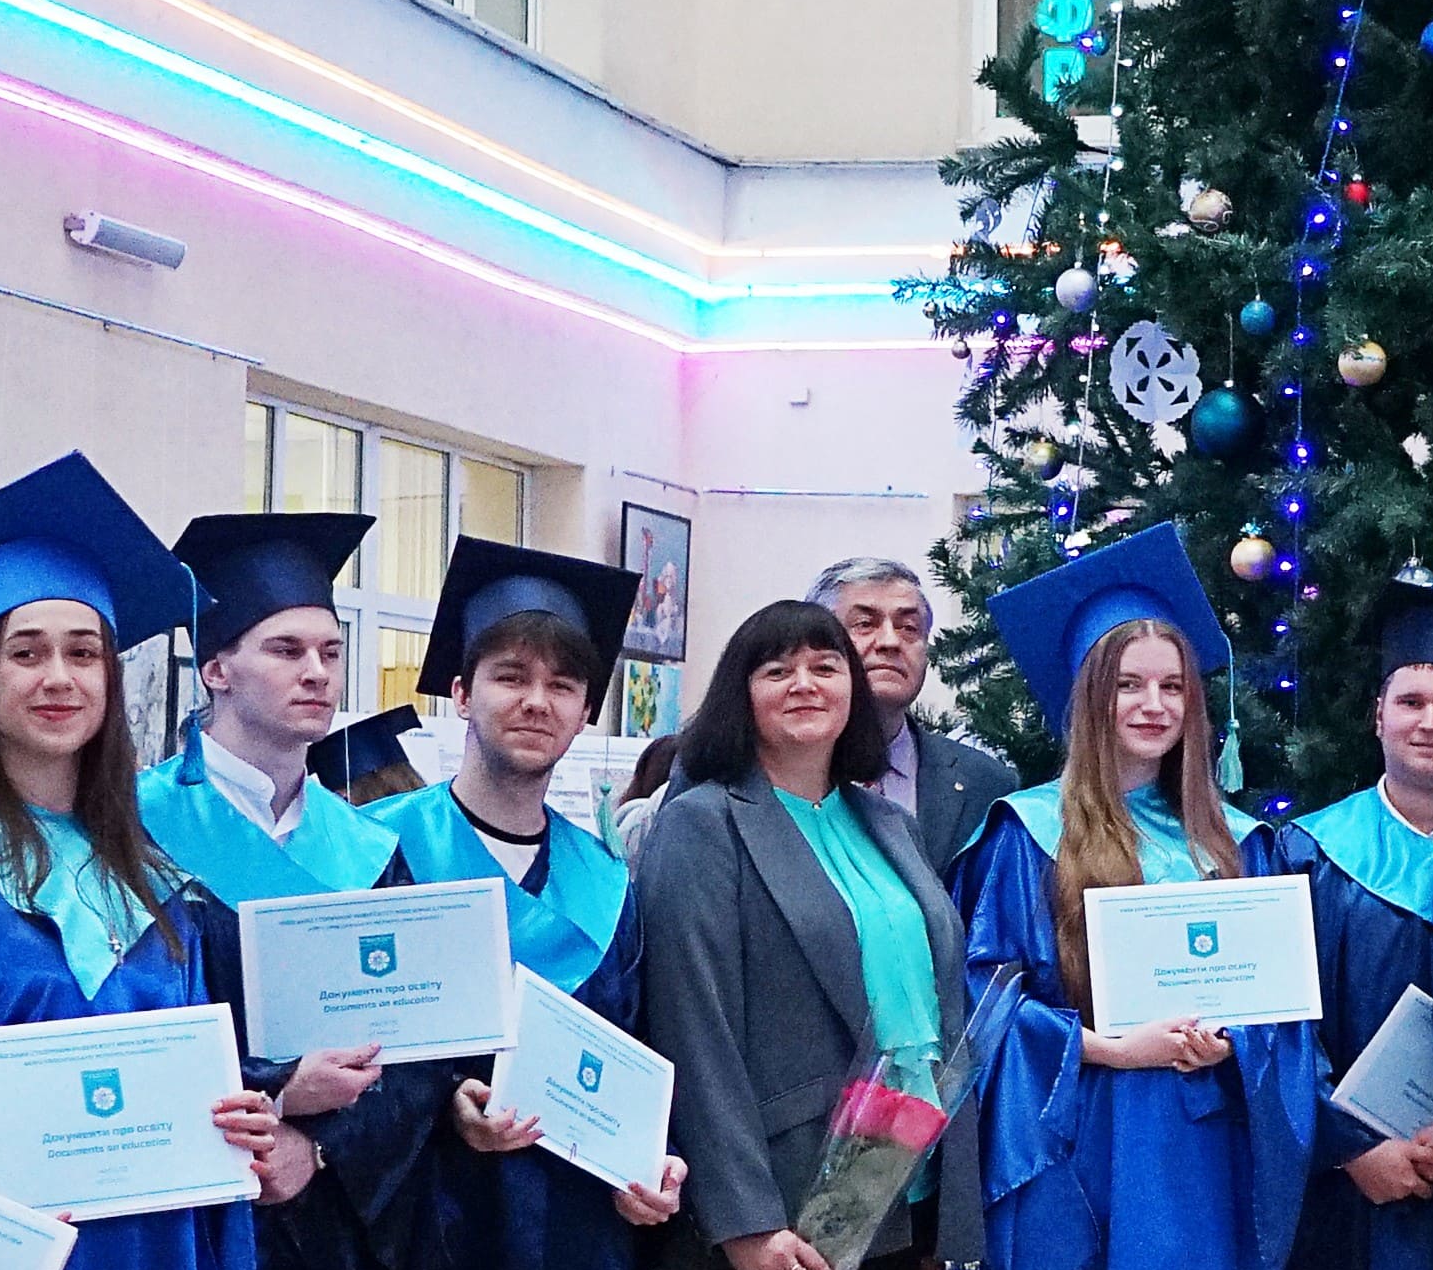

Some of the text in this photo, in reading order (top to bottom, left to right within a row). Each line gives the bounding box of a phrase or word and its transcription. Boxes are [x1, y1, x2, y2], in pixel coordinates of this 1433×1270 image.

[319, 980, 443, 1001] Документи про освіту
[323, 1002, 377, 1014] Documents
[393, 994, 439, 1006] education
[42, 1120, 174, 1146] Документи про освіту
[47, 1144, 104, 1158] Documents
[121, 1136, 172, 1151] education
